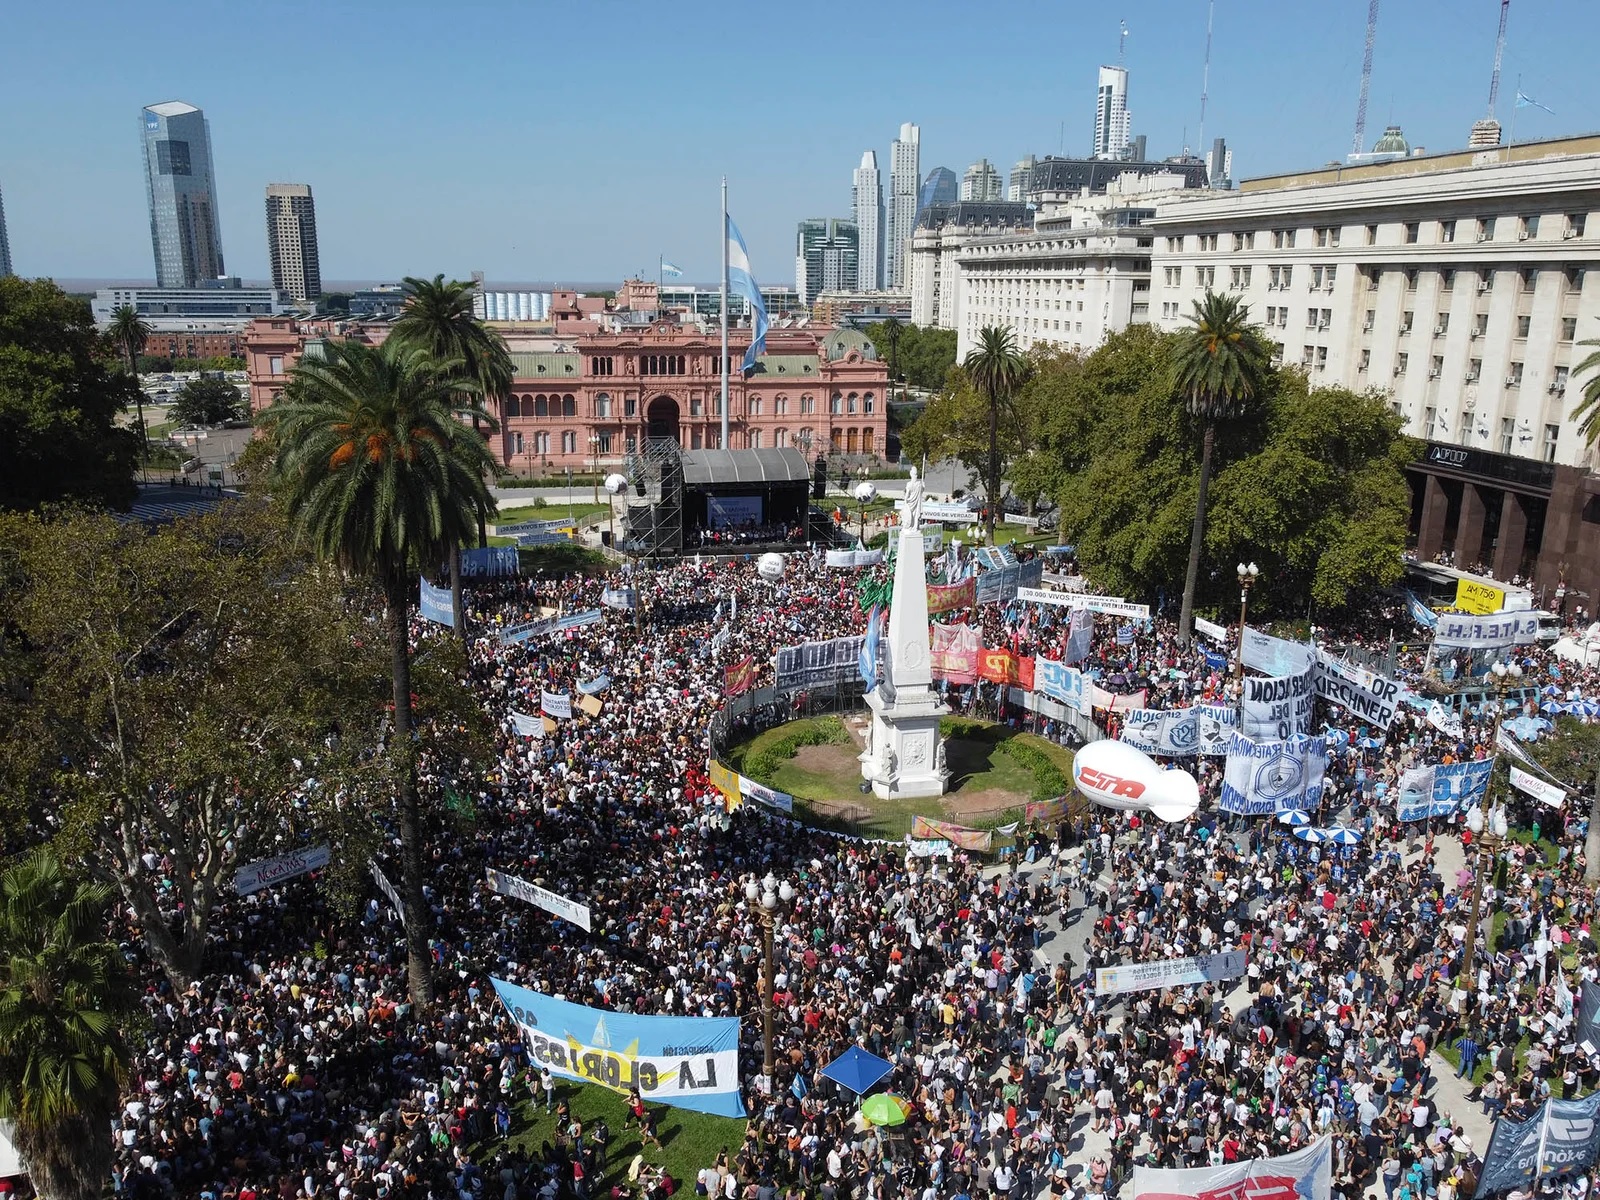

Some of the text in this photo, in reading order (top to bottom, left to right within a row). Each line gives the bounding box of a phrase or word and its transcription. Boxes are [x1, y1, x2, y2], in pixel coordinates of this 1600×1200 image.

[1466, 584, 1478, 595] AM
[1479, 587, 1495, 600] 750
[1313, 675, 1392, 726] KIRCHNER
[1079, 766, 1146, 799] CTA
